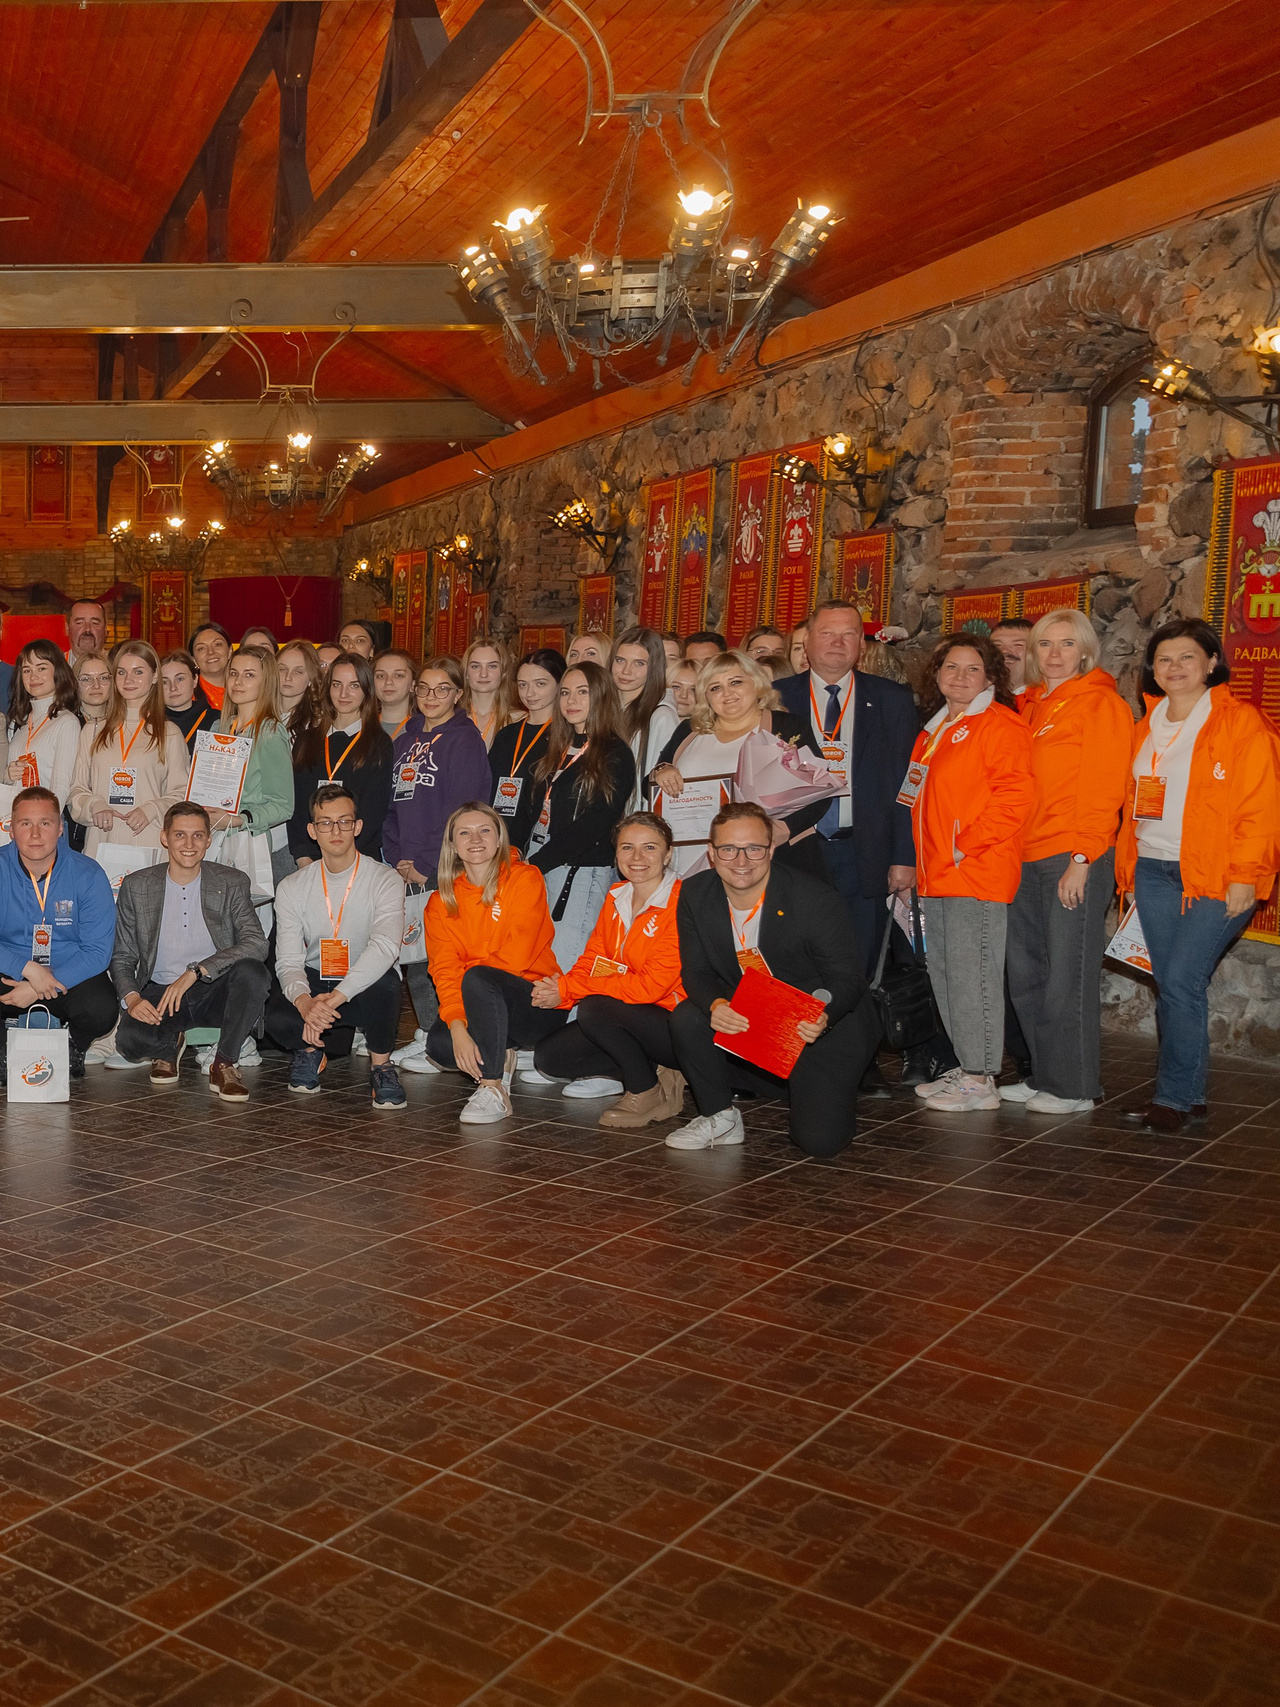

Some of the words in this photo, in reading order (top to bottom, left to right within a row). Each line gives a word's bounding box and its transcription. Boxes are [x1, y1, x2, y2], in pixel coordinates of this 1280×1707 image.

[209, 744, 236, 754] НАКАЗ
[669, 795, 713, 804] БЛАГОДАРНОСТЬ
[1129, 943, 1149, 956] КАЗ
